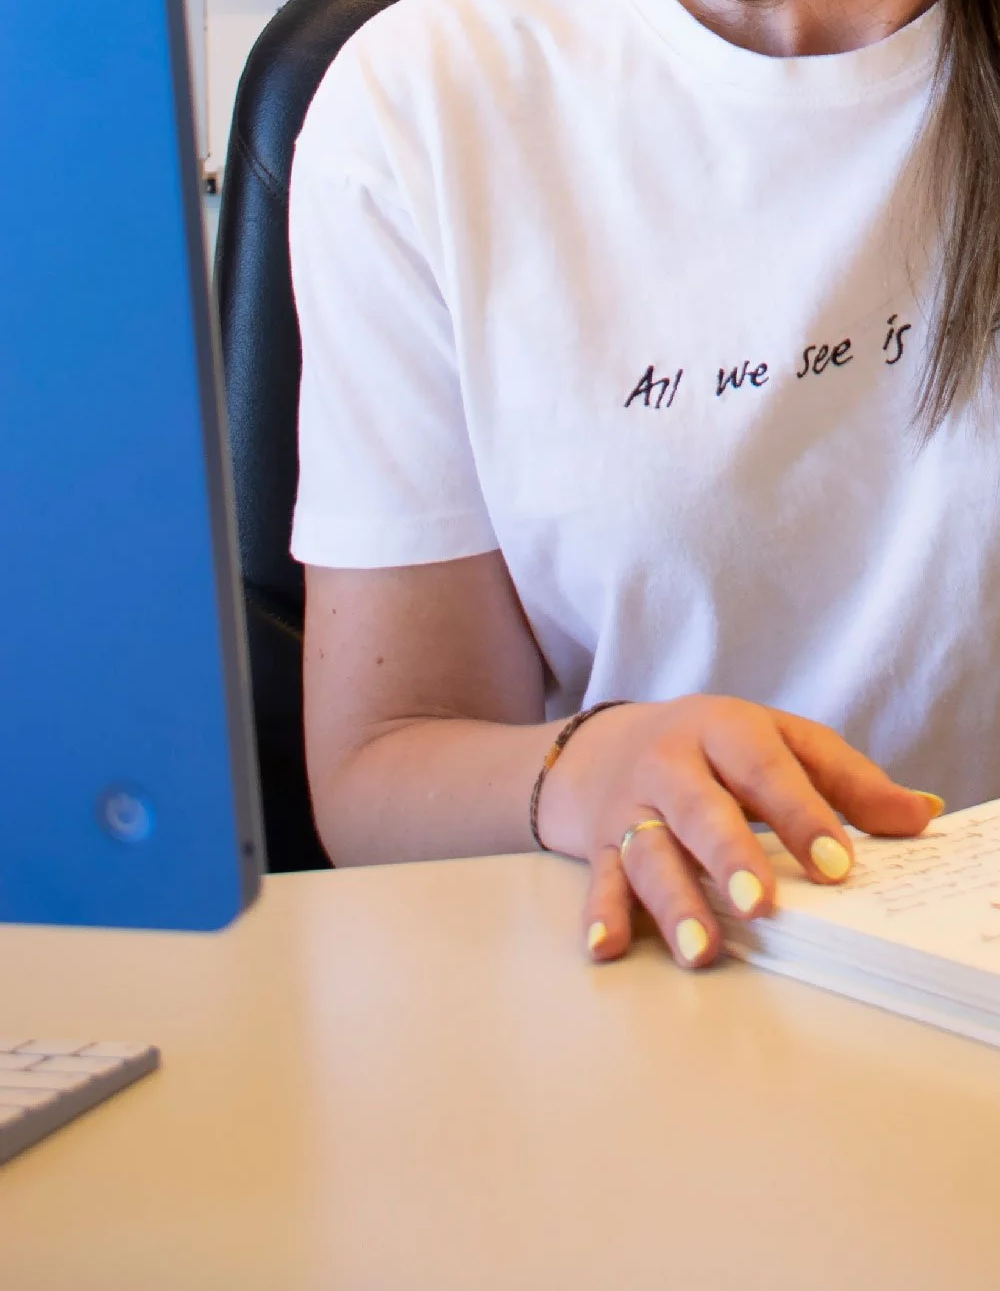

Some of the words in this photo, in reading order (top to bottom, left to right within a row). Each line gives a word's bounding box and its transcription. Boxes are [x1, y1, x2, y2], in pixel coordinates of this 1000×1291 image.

[624, 365, 683, 409] All
[715, 360, 769, 397] we
[797, 338, 854, 378] see
[883, 314, 912, 365] is
